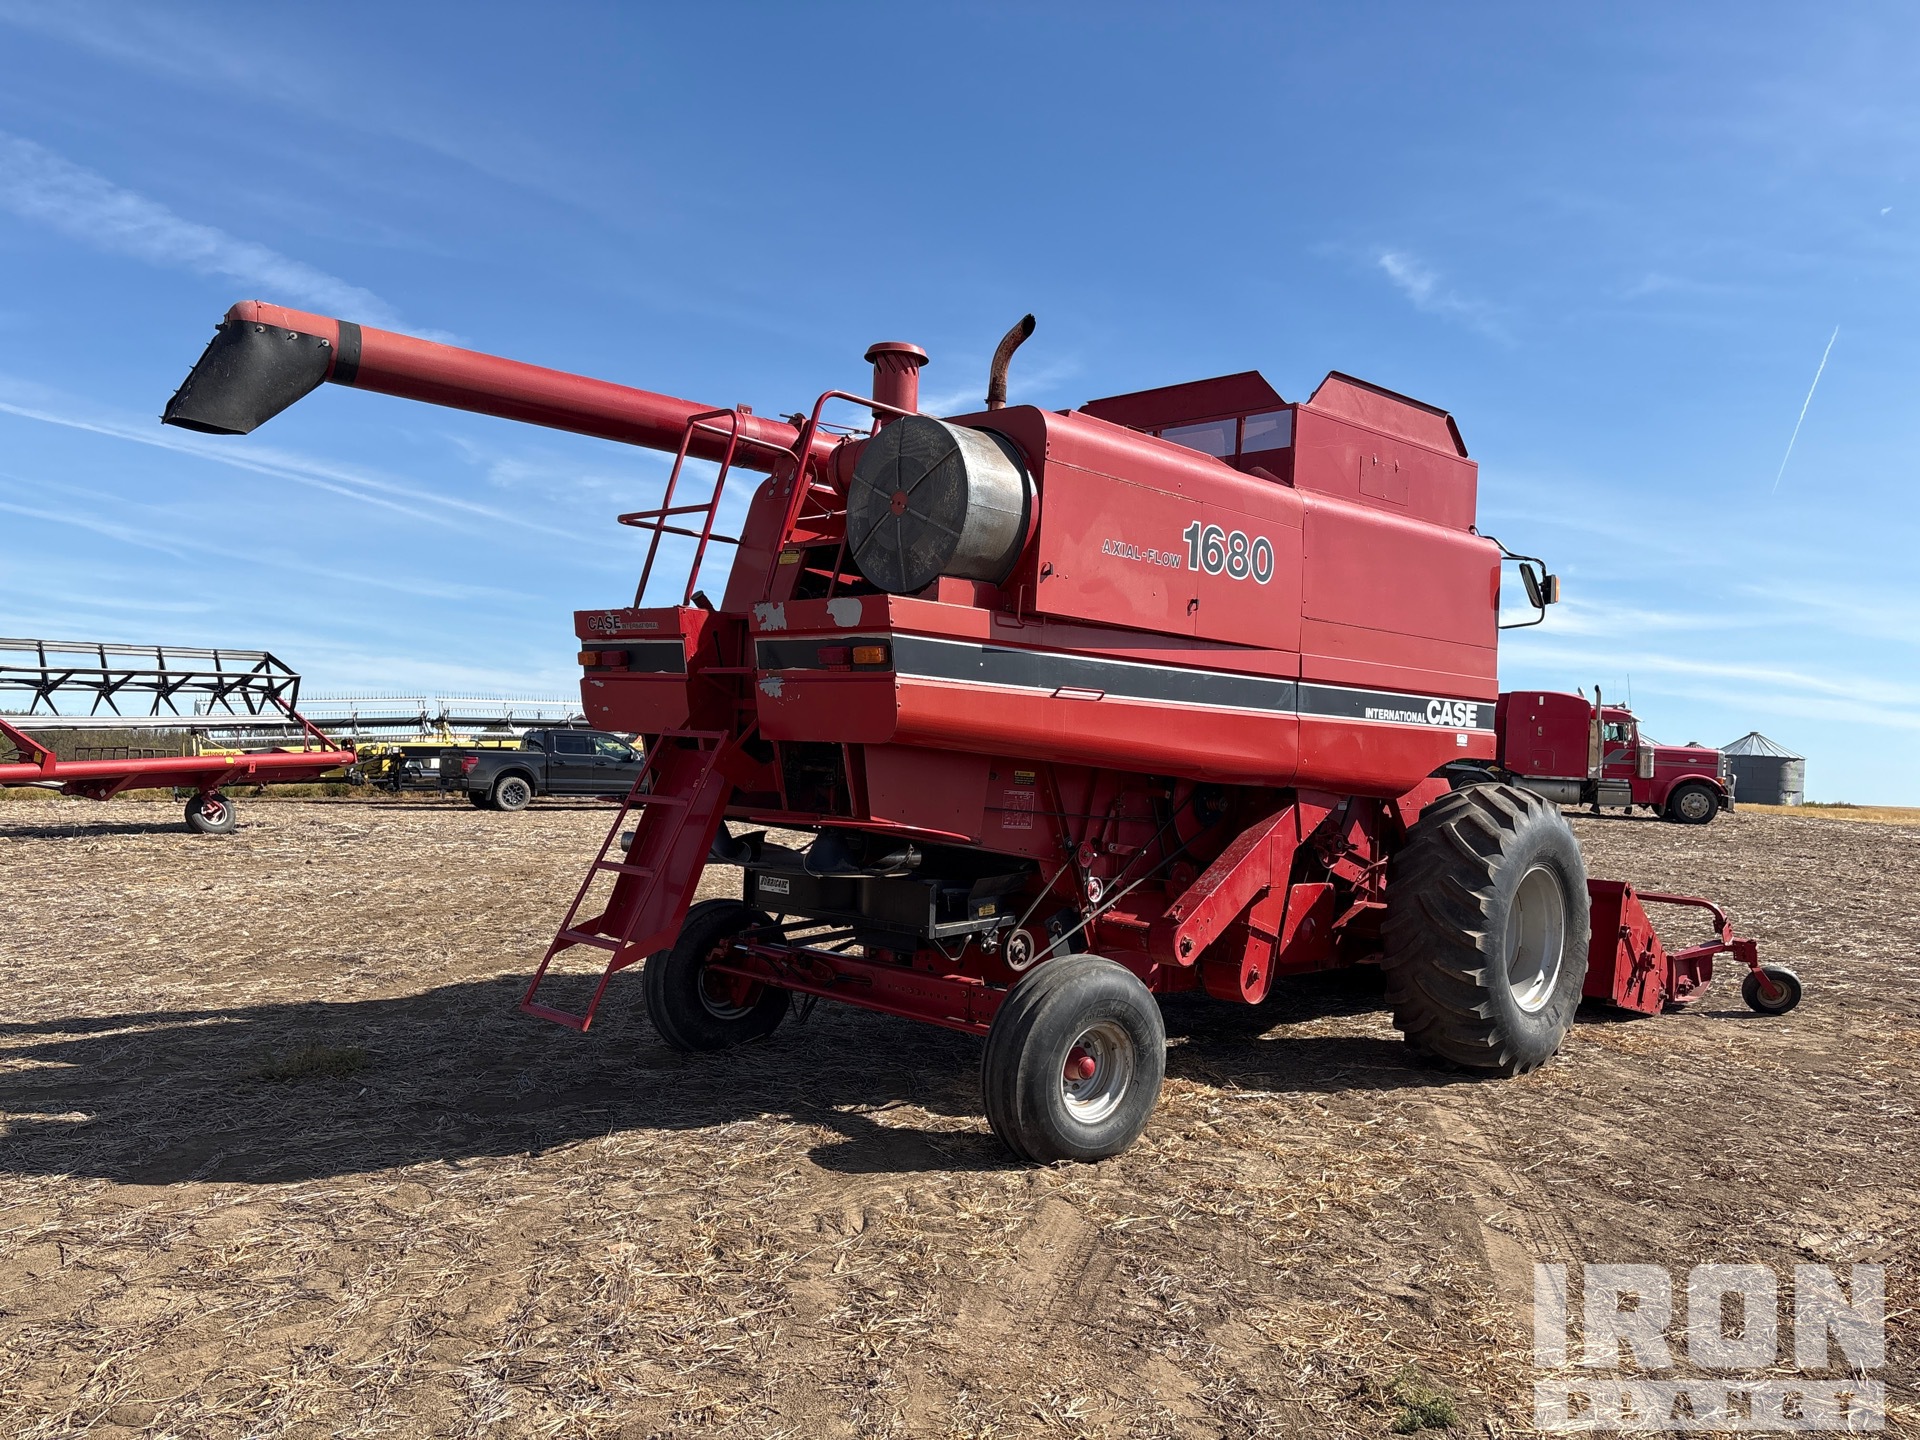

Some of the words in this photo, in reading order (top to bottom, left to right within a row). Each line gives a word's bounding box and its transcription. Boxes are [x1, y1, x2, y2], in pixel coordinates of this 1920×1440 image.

[1102, 539, 1182, 569] AXIAL-FLOW
[1183, 520, 1275, 585] 1680
[588, 615, 620, 630] CASE
[1365, 707, 1426, 723] INTERNATIONAL
[1426, 699, 1477, 727] CASE
